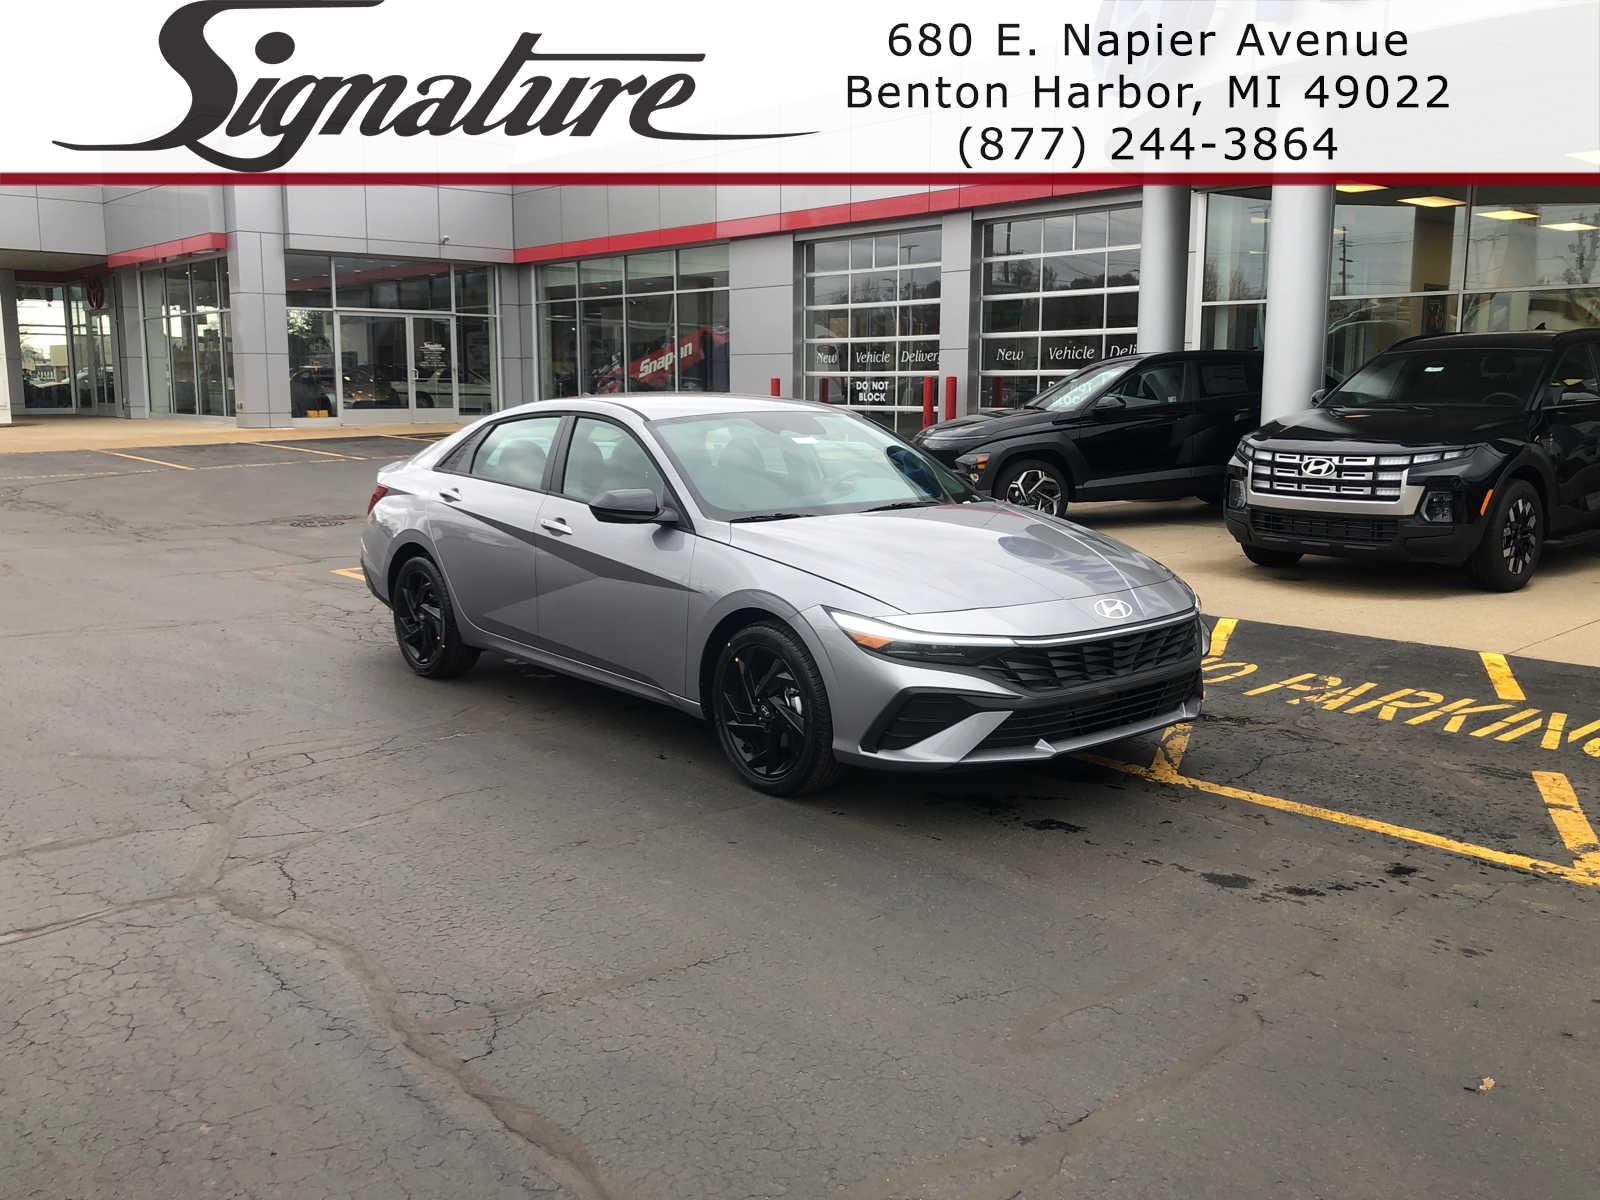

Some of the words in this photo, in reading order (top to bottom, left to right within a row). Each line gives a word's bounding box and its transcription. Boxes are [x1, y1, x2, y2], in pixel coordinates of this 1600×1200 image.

[638, 342, 693, 378] Snap-n
[816, 351, 839, 363] New
[856, 351, 891, 363] Vehicle
[901, 350, 940, 365] Deliver
[996, 348, 1024, 361] New
[1049, 345, 1096, 360] Vehicle
[856, 381, 869, 391] DO
[871, 381, 889, 391] NOT
[858, 392, 886, 402] BLOCK
[1240, 672, 1600, 759] PARKIN
